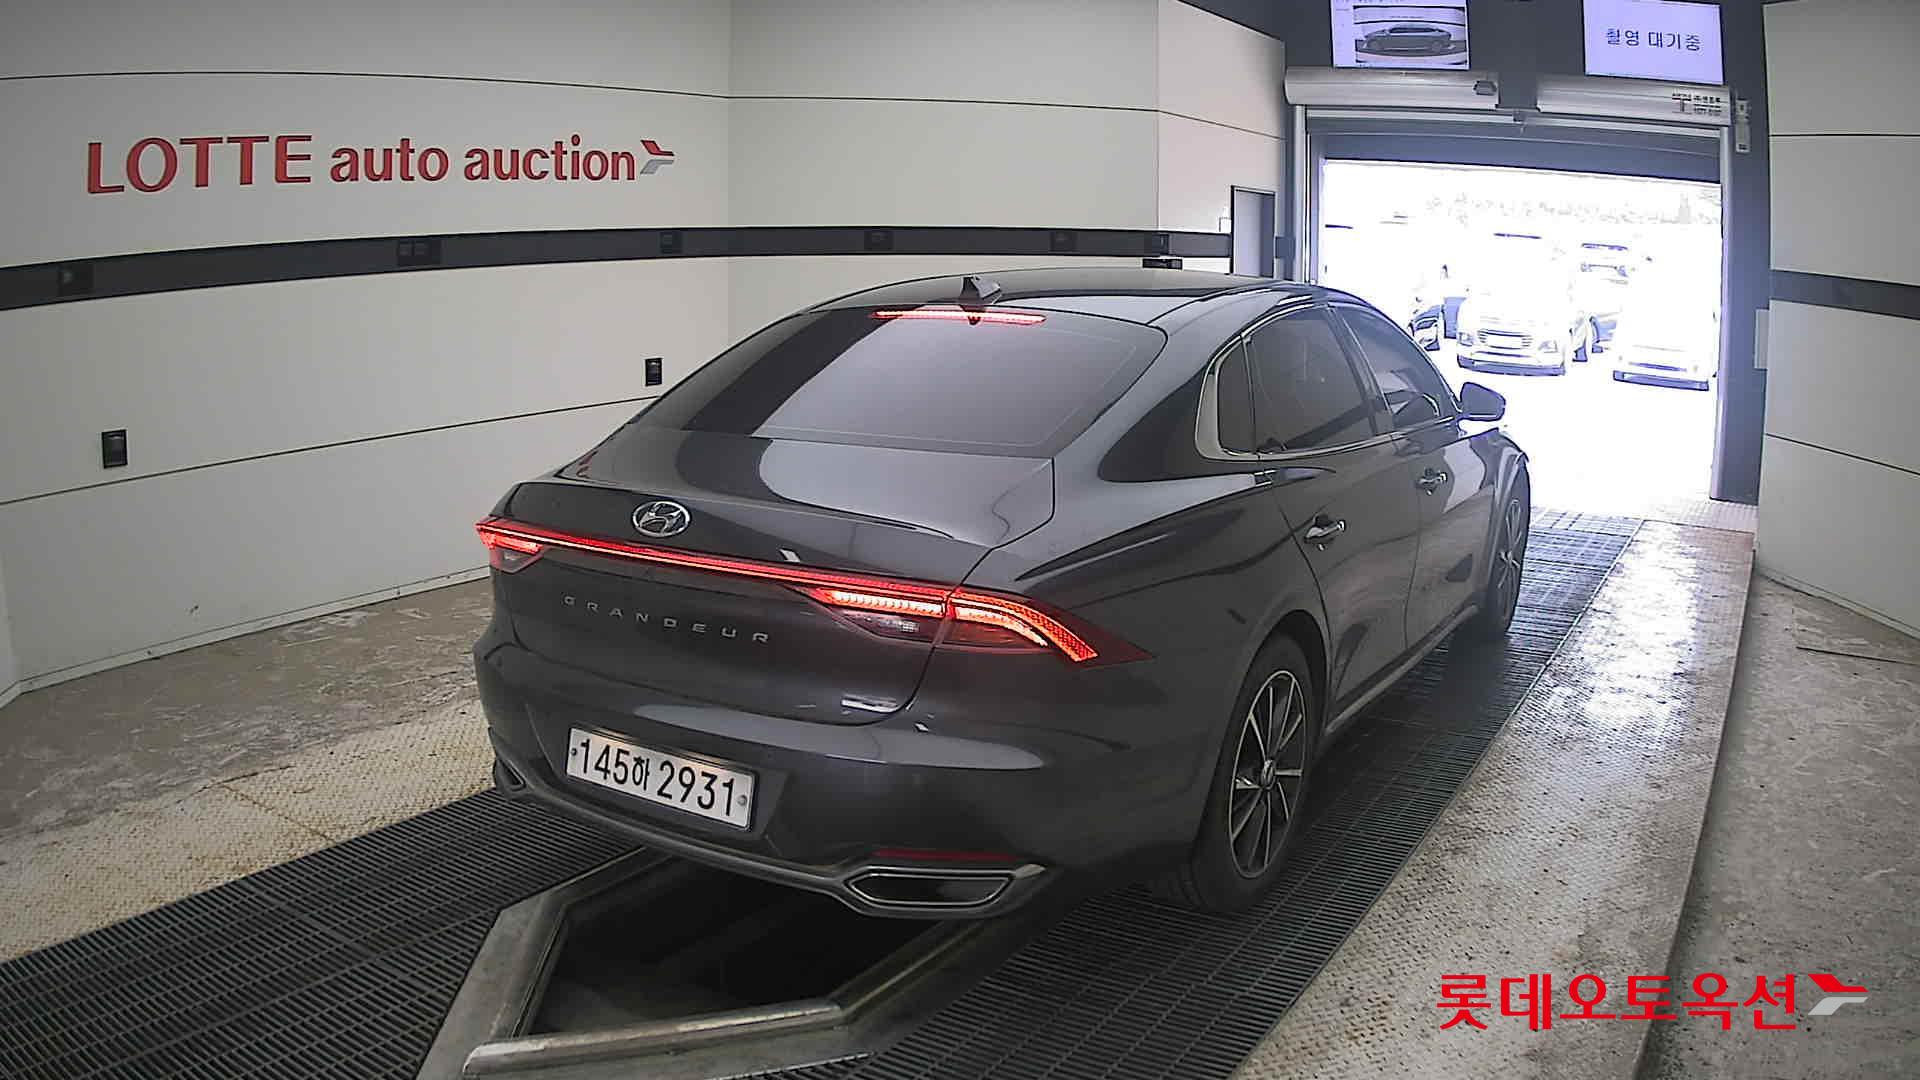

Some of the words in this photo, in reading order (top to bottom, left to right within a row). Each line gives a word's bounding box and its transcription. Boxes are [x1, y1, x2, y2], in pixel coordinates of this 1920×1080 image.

[1648, 31, 1701, 52] 대기중
[87, 134, 313, 194] LOTTE
[330, 138, 449, 183] auto
[464, 134, 636, 182] auction
[564, 594, 769, 643] GRANDEUR
[580, 738, 650, 791] 145하
[656, 760, 735, 817] 2931
